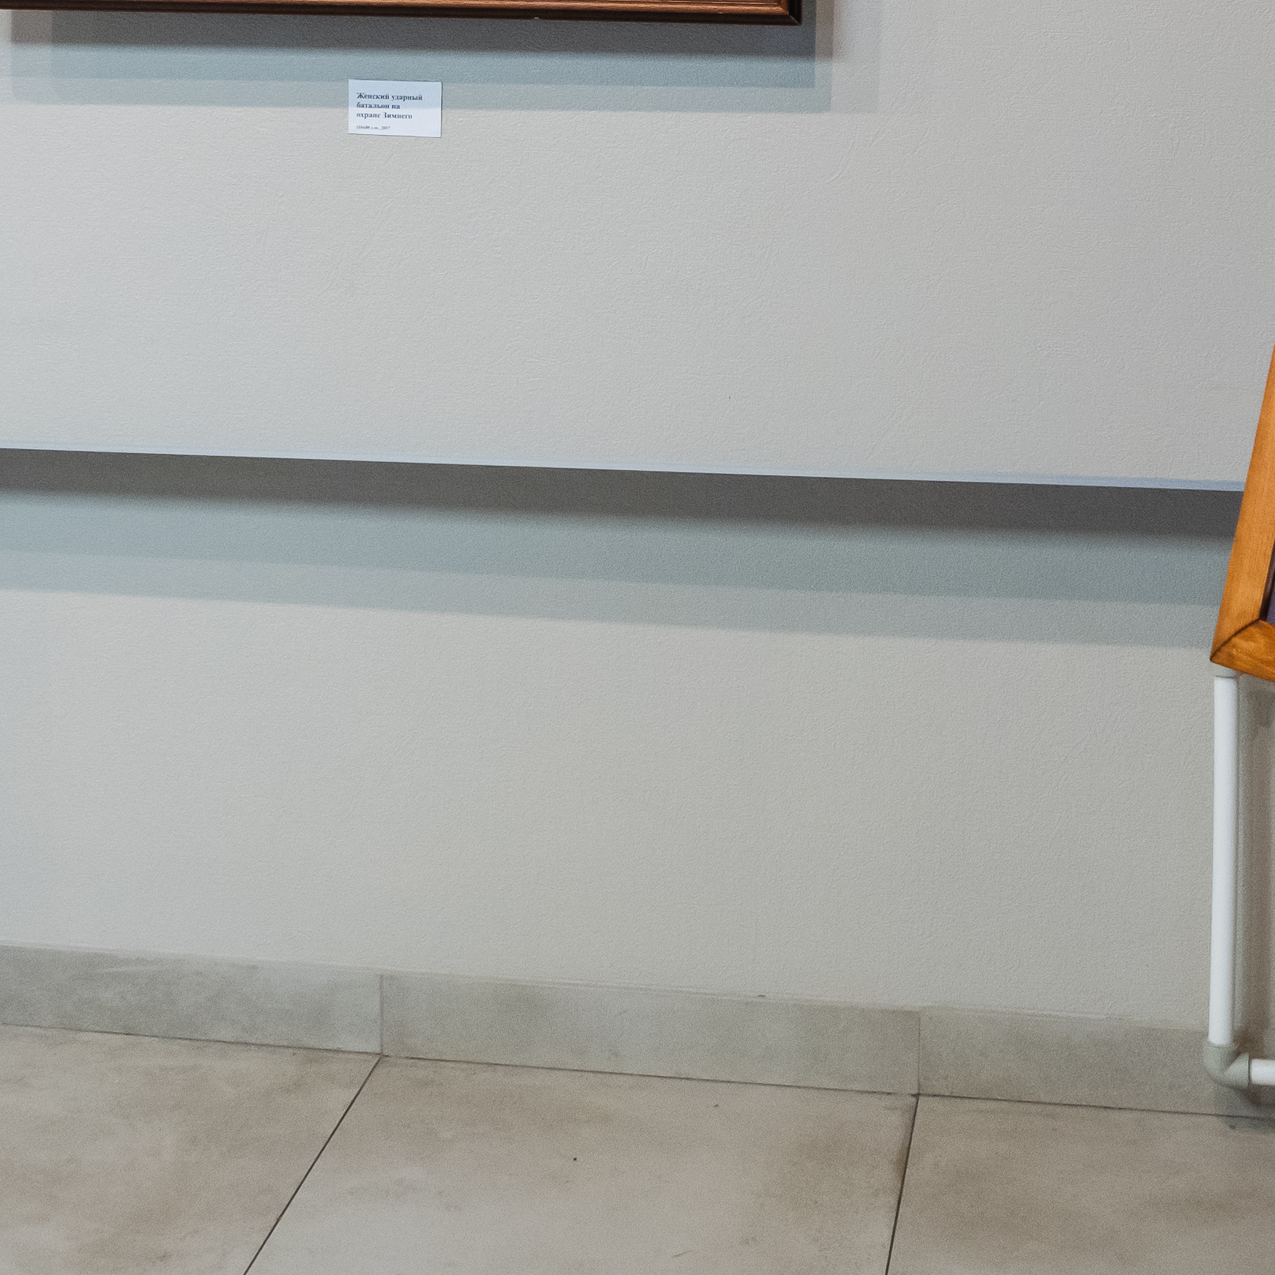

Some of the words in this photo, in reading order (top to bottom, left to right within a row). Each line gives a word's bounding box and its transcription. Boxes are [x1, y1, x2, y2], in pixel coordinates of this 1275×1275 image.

[356, 92, 390, 100] Женский
[391, 94, 423, 102] ударный
[356, 112, 381, 120] охране
